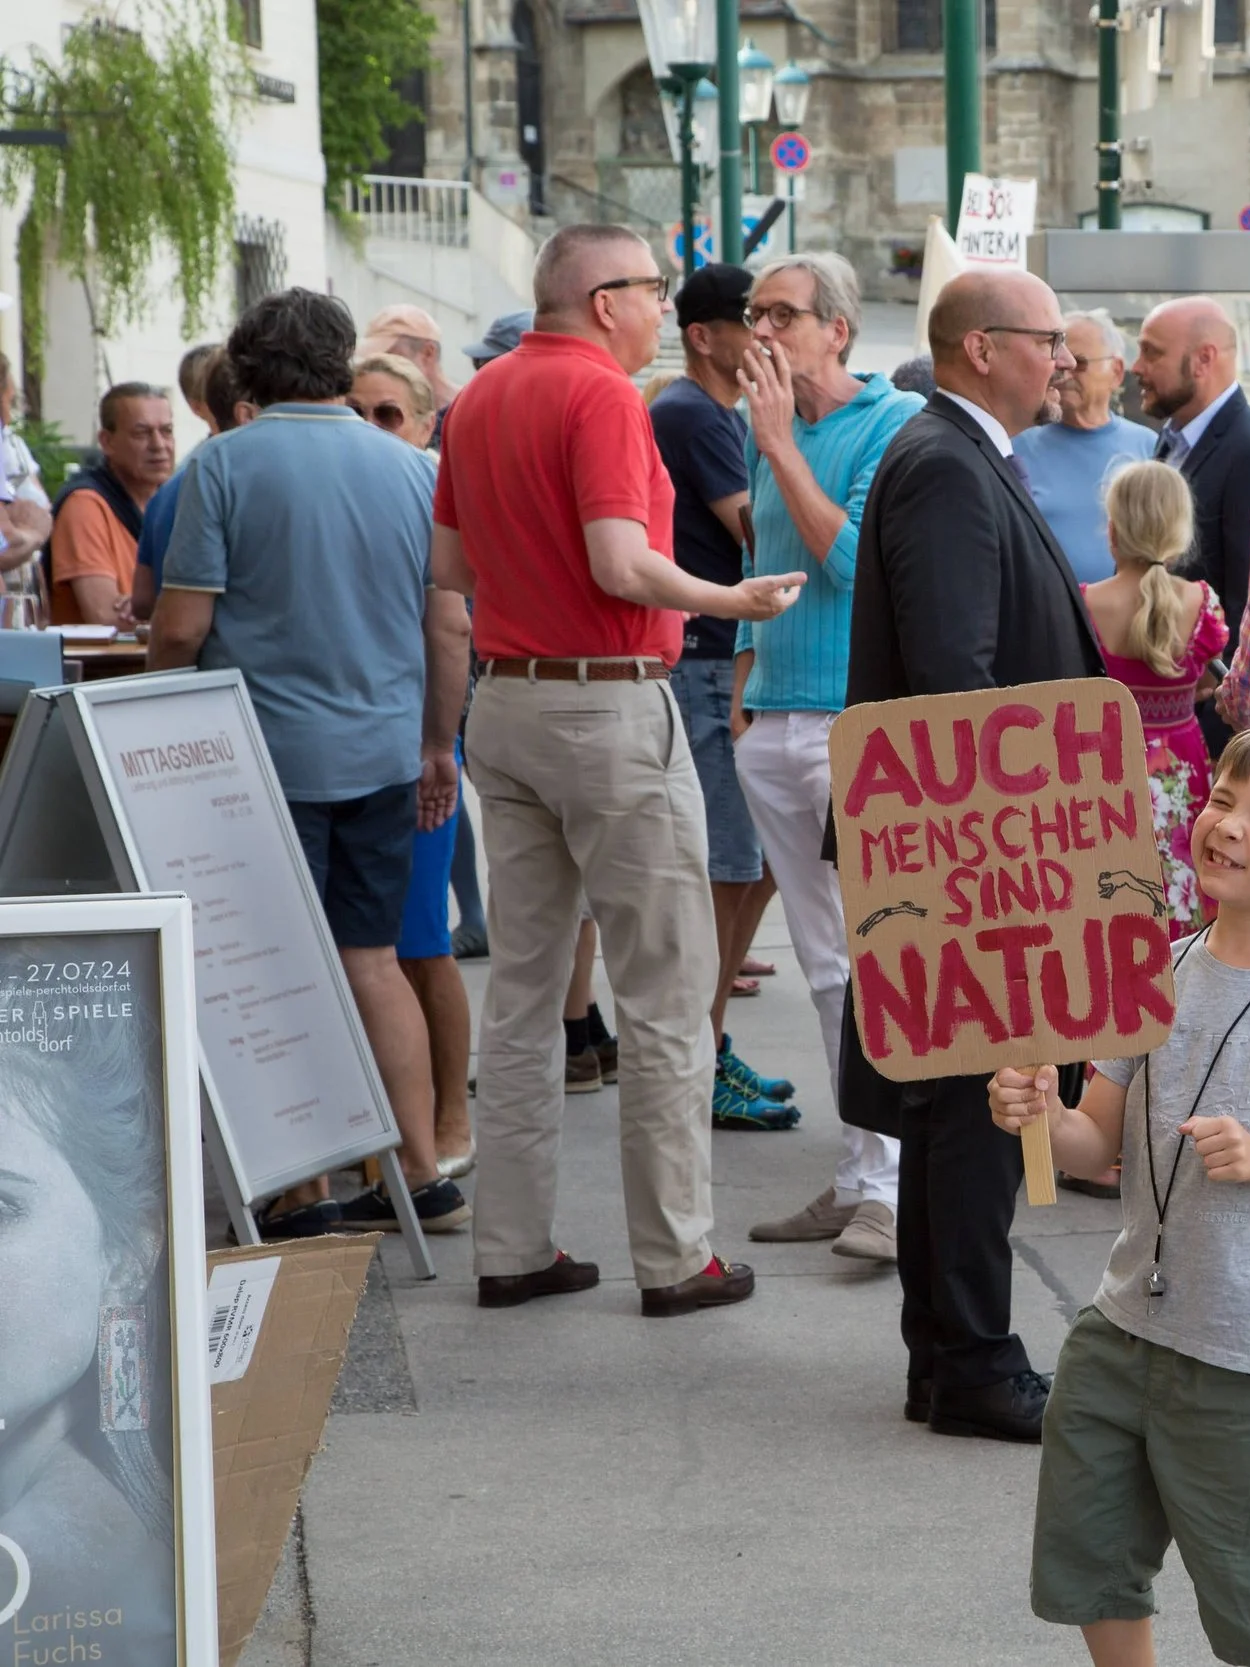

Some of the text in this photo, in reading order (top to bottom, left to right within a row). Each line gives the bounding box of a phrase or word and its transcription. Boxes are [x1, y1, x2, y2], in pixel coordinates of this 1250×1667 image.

[120, 731, 235, 778] MITTAGSMENÜ
[843, 700, 1125, 818] AUCH
[860, 789, 1138, 885] MENSCHEN
[942, 858, 1073, 927] SIND
[27, 960, 132, 982] 27.07.24
[856, 912, 1175, 1061] NATUR
[53, 1002, 133, 1021] SPIELE
[38, 1035, 74, 1052] dorf
[13, 1605, 123, 1635] Larissa
[13, 1634, 103, 1667] Fuchs
